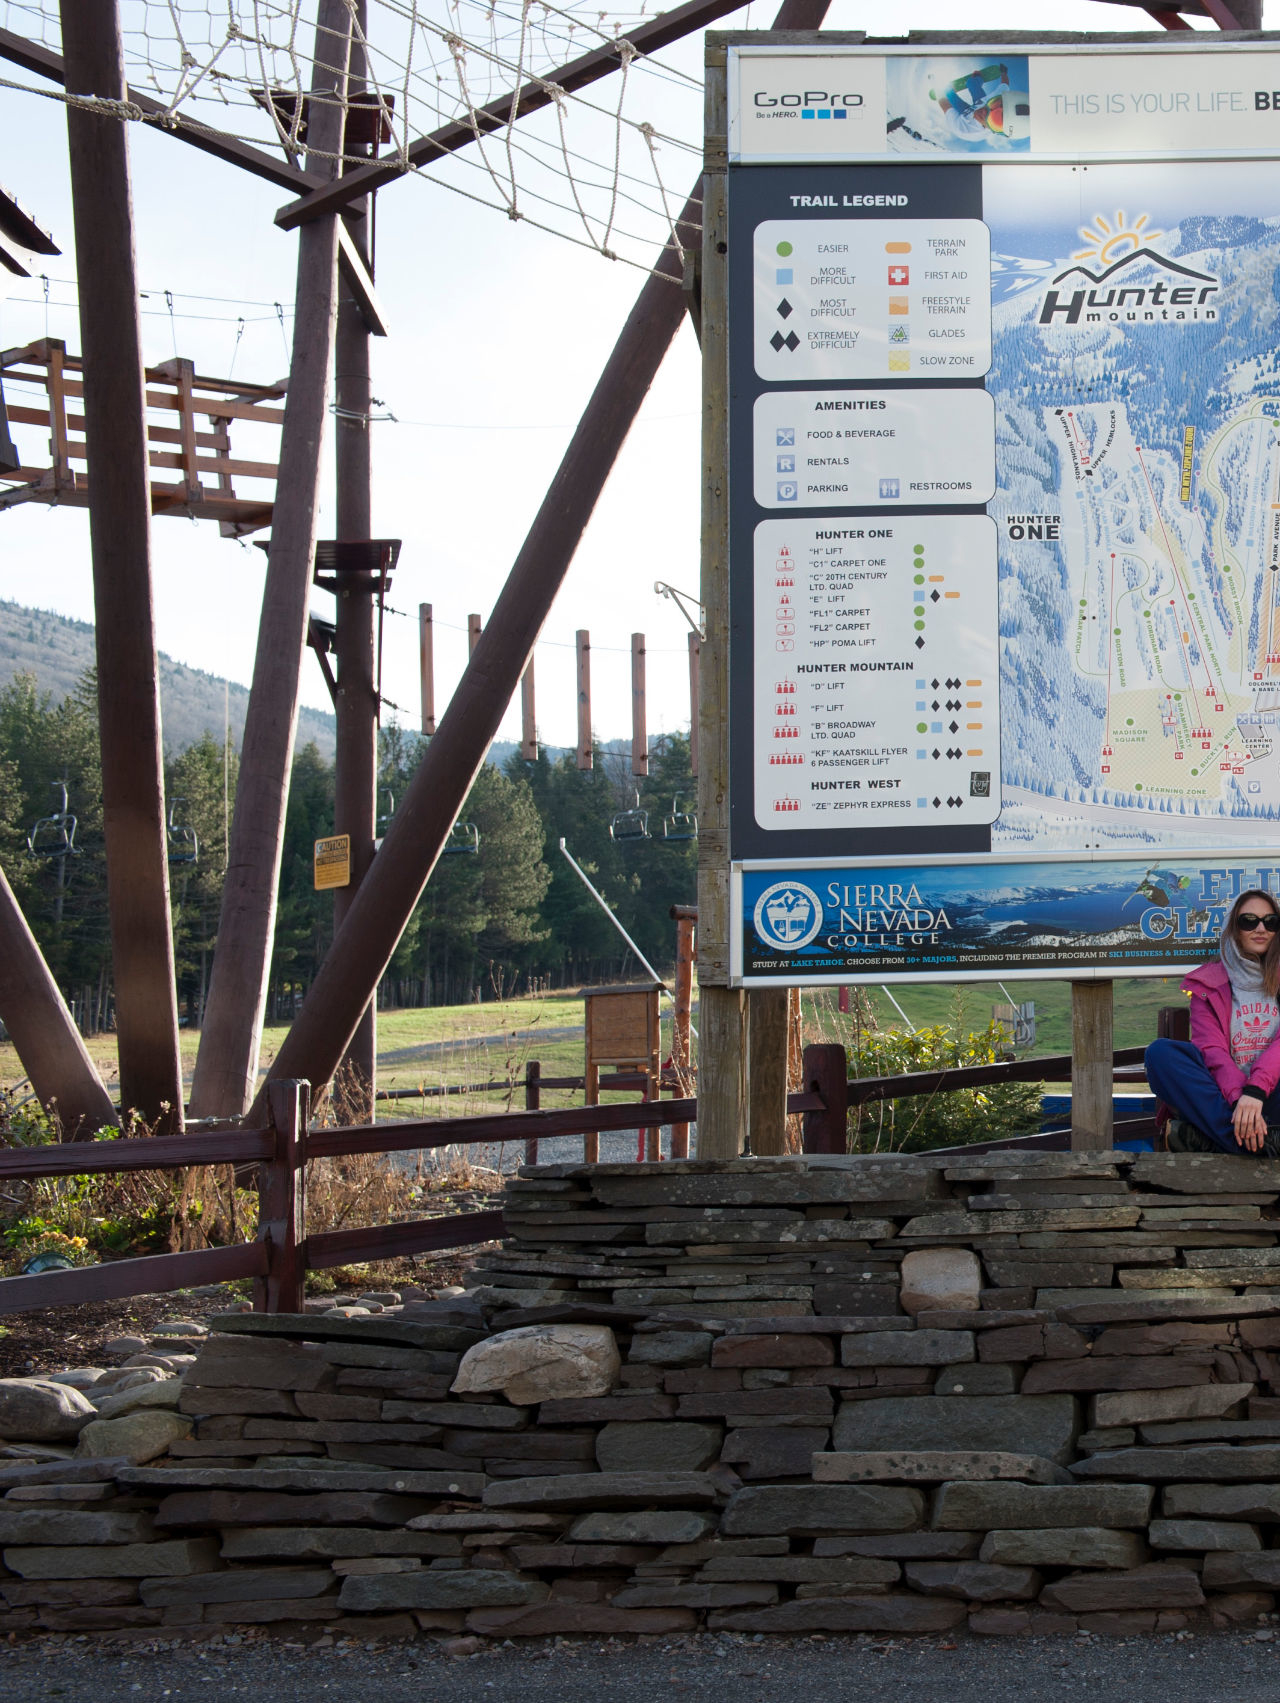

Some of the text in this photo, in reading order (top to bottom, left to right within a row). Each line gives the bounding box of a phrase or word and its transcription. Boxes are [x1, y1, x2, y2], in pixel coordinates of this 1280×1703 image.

[755, 92, 864, 106] GoPro
[1051, 95, 1099, 114] THIS
[1106, 94, 1125, 113] IS
[1131, 93, 1189, 113] YOUR
[1197, 92, 1247, 112] LIFE.
[790, 195, 908, 206] TRAIL LEGEND
[818, 245, 848, 253] EASIER
[811, 276, 856, 285] DIFFICULT
[820, 299, 846, 307] MOST
[922, 297, 970, 305] FREESTYLE
[1039, 282, 1218, 324] Hunter
[811, 308, 856, 317] DIFFICULT
[927, 306, 966, 314] TERRAIN
[1087, 308, 1215, 322] mountain
[808, 332, 859, 340] EXTREMELY
[811, 340, 856, 349] DIFFICULT
[920, 357, 974, 365] SLOW ZONE
[815, 401, 886, 410] AMENITIES
[807, 431, 833, 439] FOOD
[845, 429, 895, 438] BEVERAGE
[808, 484, 848, 493] PARKING
[910, 482, 972, 491] RESTROOMS
[816, 530, 893, 539] HUNTER ONE
[1009, 525, 1059, 540] ONE
[848, 572, 887, 580] CENTURY
[836, 623, 870, 631] CARPET
[797, 662, 914, 673] HUNTER MOUNTAIN
[828, 721, 876, 729] BROADWAY
[833, 748, 879, 756] KAATSKILL
[818, 759, 870, 767] PASSENGER
[811, 780, 901, 790] HUNTER WEST
[1146, 786, 1184, 794] LEARNING
[871, 800, 911, 808] EXPRESS
[316, 839, 347, 853] CAUTION
[827, 882, 924, 911] SIERRA
[840, 908, 952, 933] NEVADA
[828, 933, 939, 947] COLLEGE
[1236, 1003, 1278, 1019] ADIDAS
